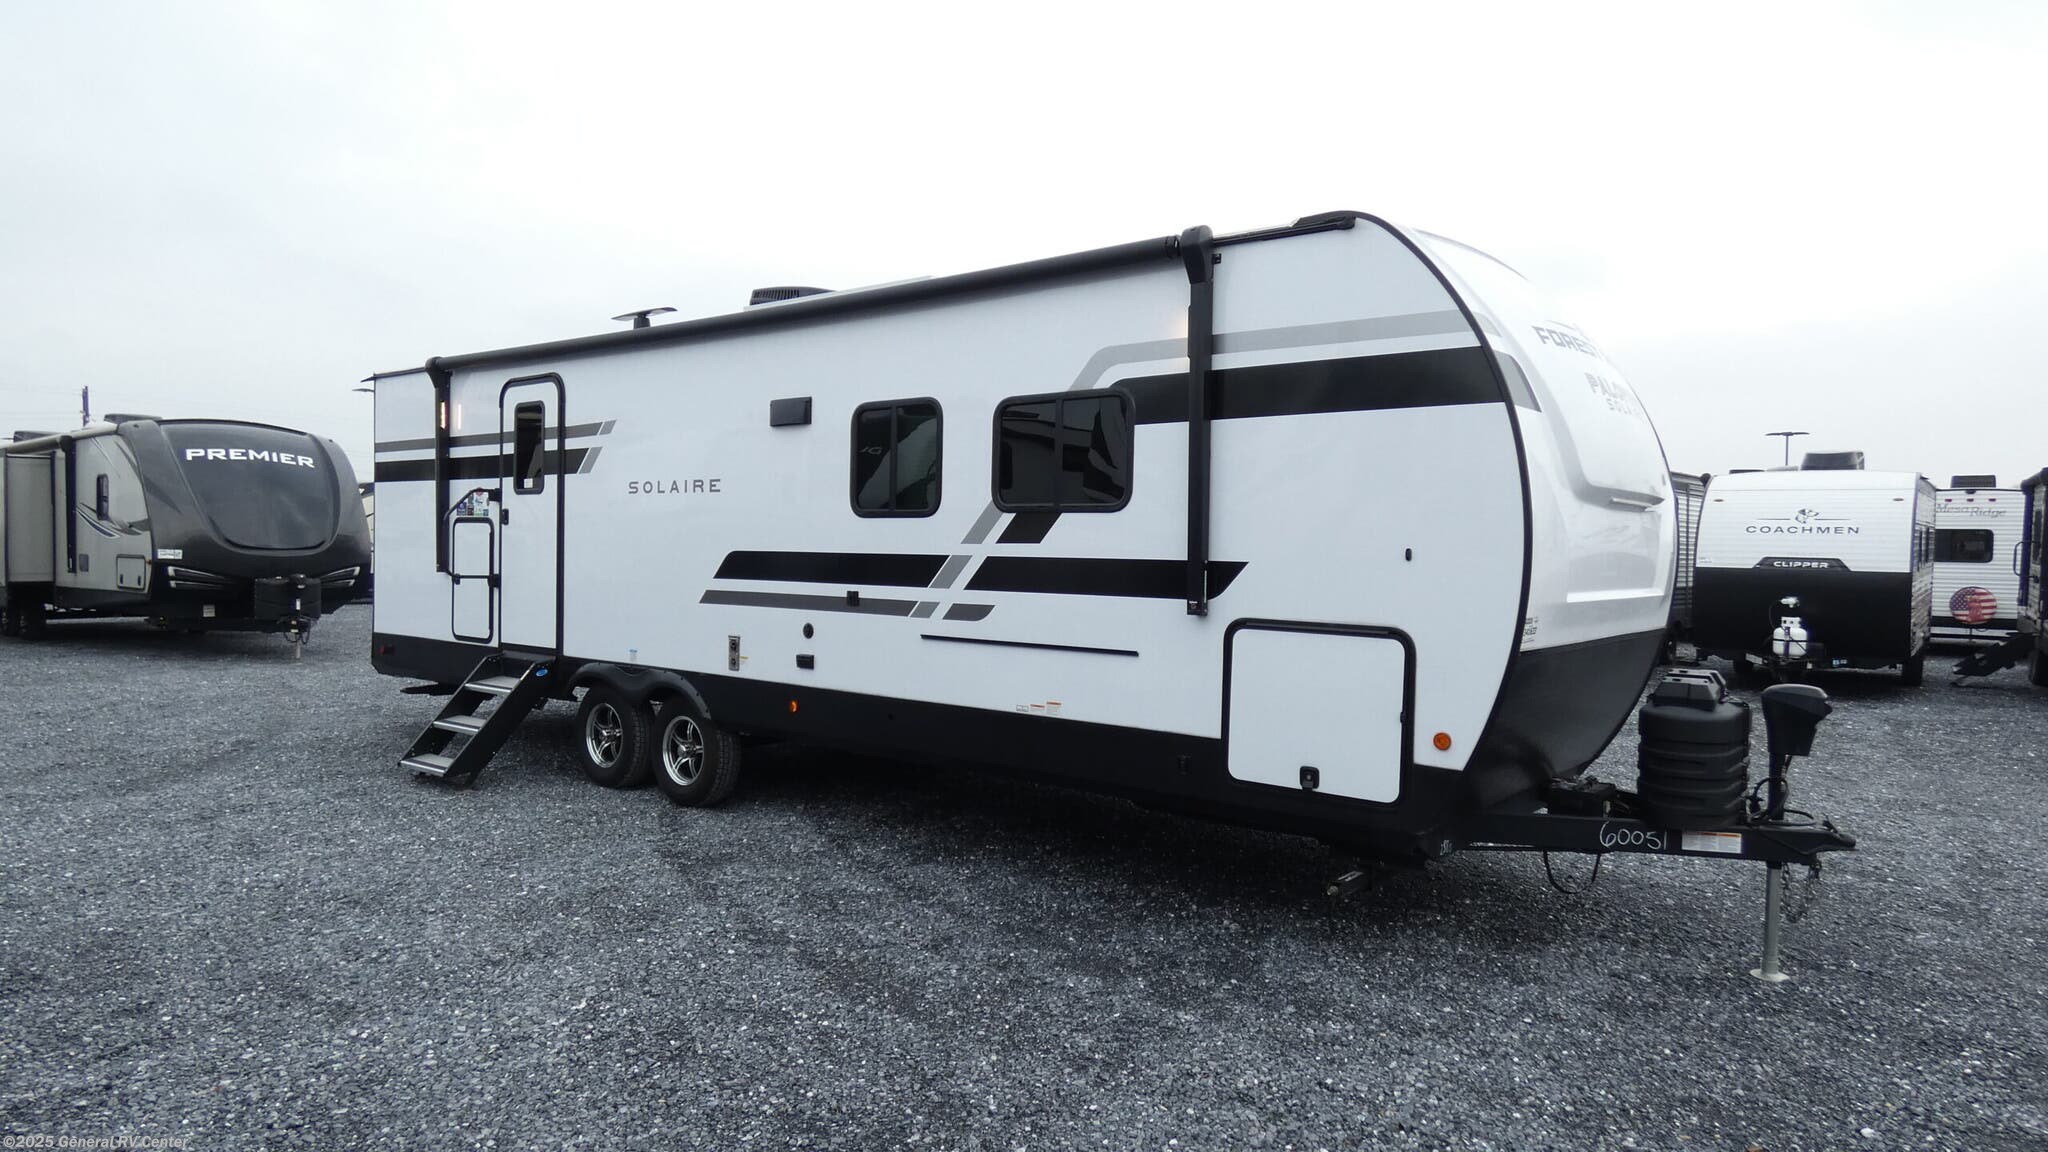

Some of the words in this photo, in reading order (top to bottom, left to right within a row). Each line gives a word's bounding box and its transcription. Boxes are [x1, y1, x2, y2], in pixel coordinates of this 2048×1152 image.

[185, 448, 315, 468] PREMIER
[628, 479, 721, 494] SOLAIRE
[1969, 506, 2007, 518] Ridge
[1746, 525, 1859, 535] COACHMEN
[1773, 560, 1829, 568] CLIPPER
[1600, 821, 1667, 850] 60051
